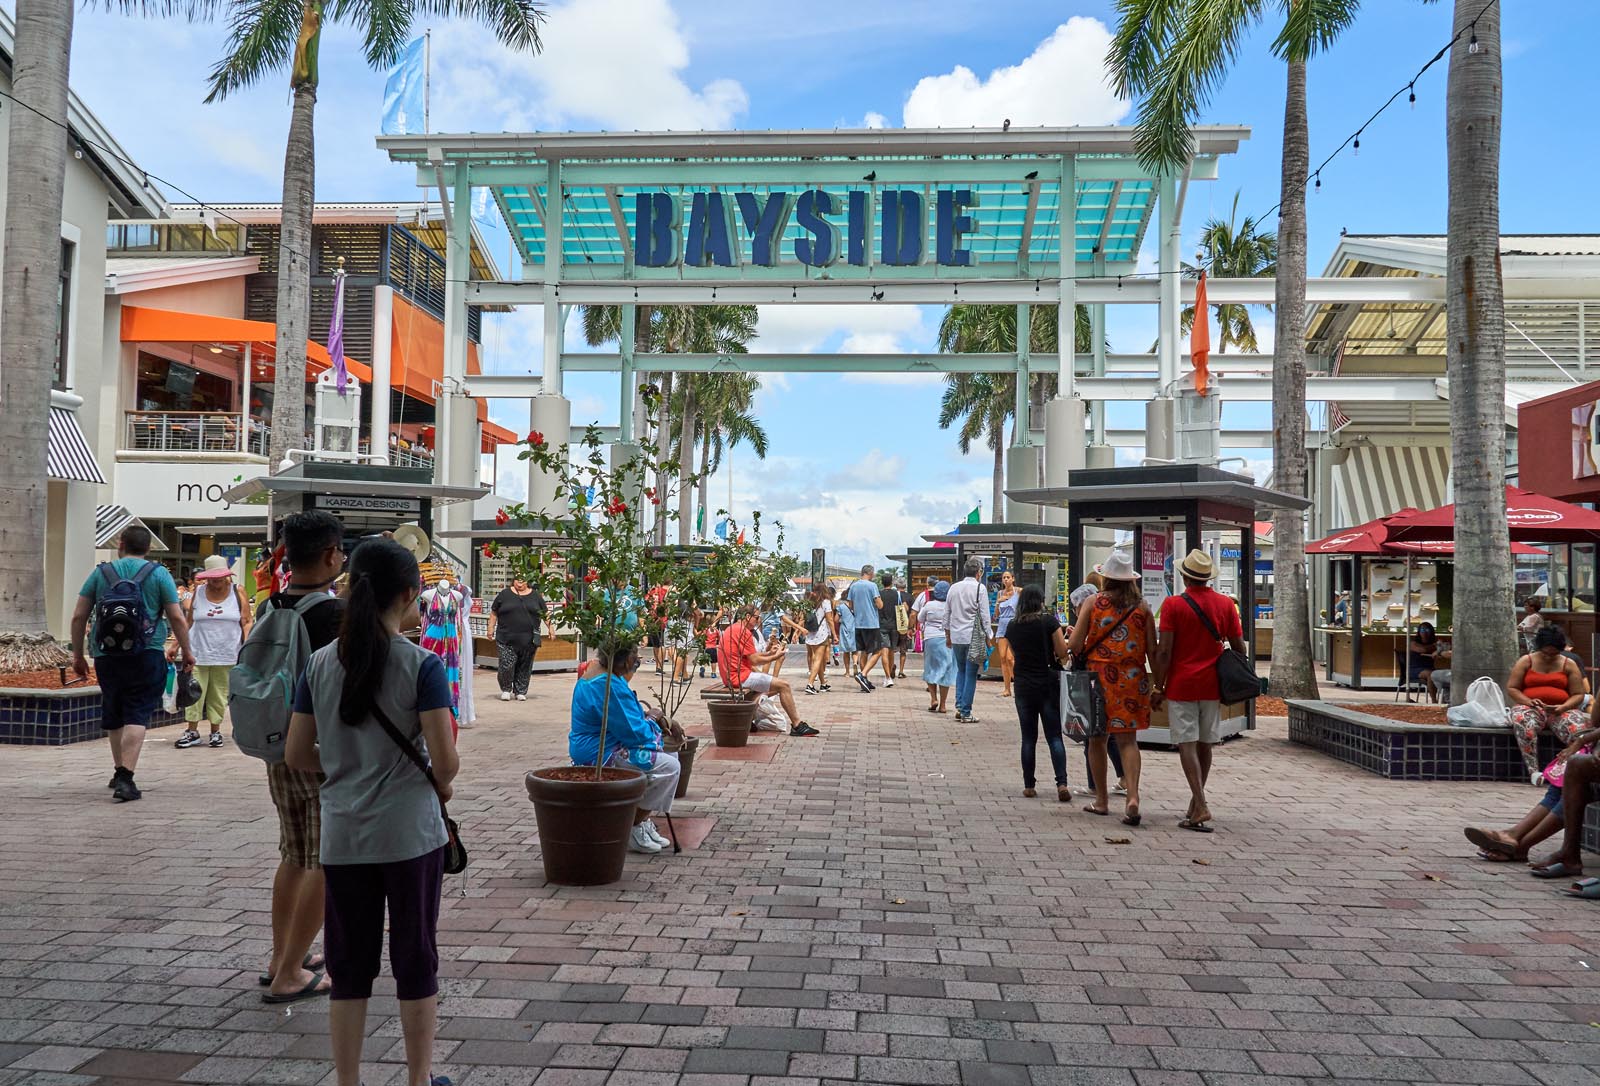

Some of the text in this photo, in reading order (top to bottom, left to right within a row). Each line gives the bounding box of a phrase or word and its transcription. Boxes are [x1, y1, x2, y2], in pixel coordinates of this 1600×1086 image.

[634, 189, 979, 267] BAYSIDE
[325, 498, 410, 510] KARIZA DESIGNS
